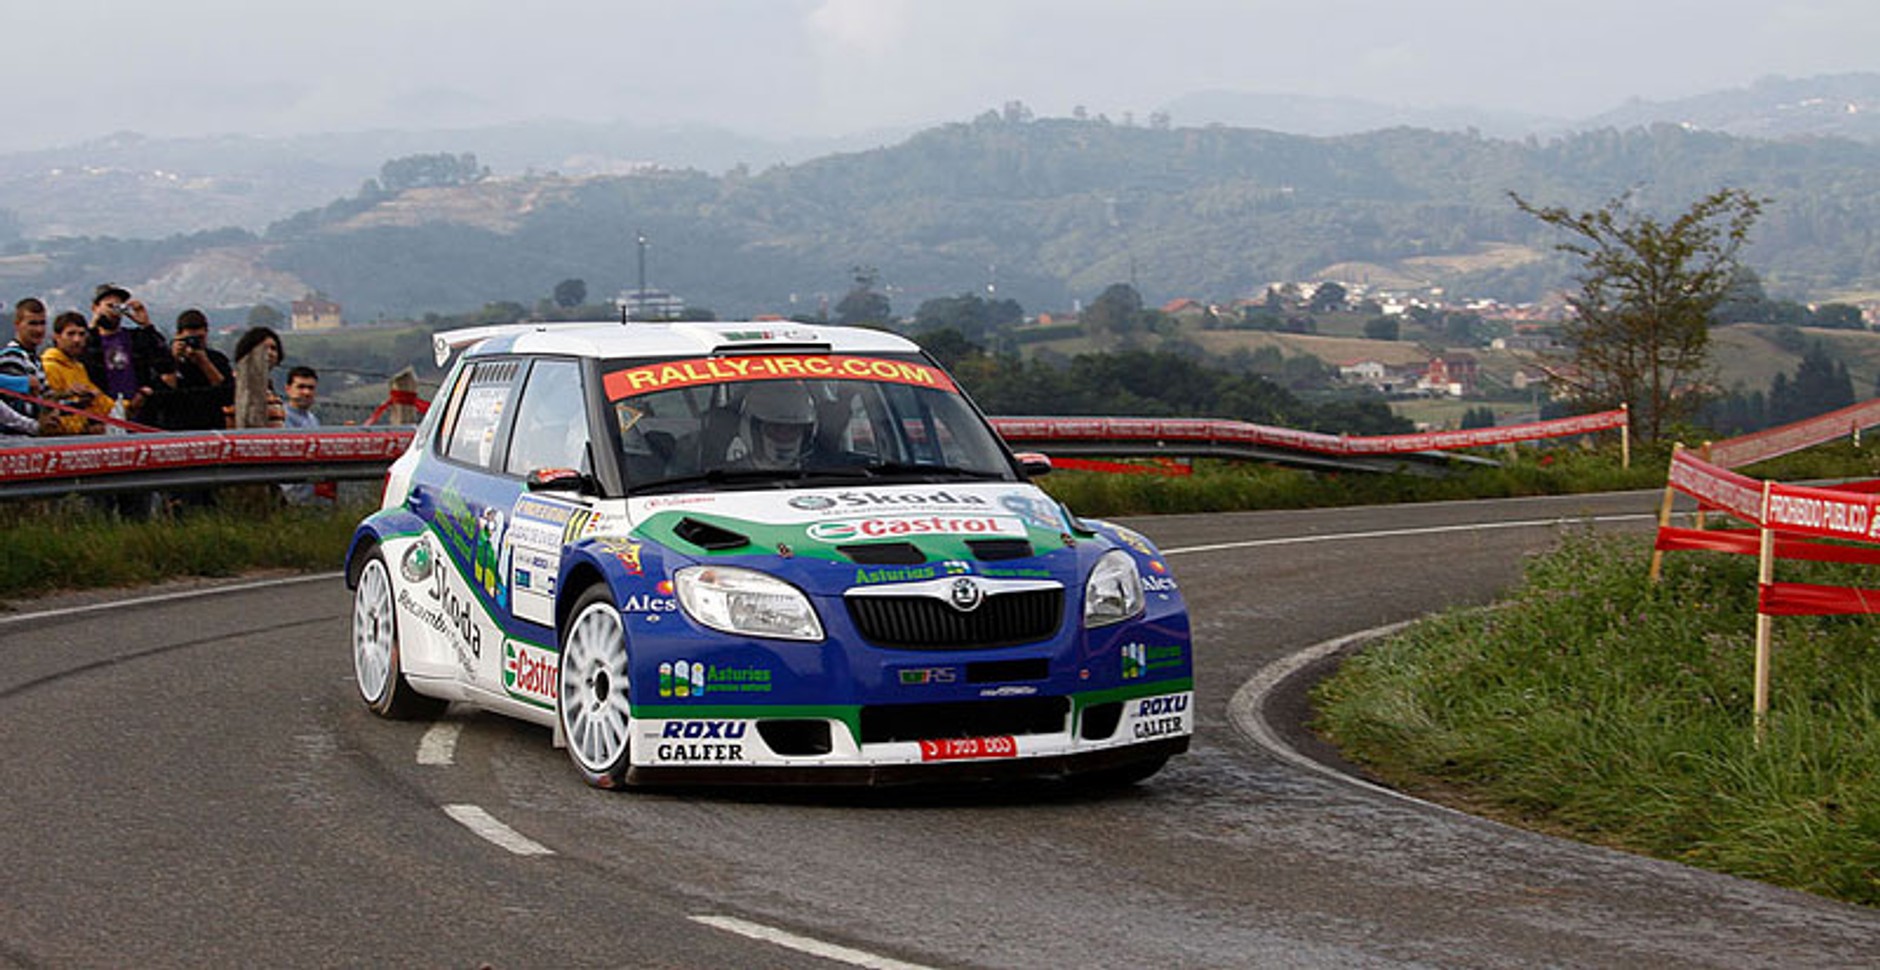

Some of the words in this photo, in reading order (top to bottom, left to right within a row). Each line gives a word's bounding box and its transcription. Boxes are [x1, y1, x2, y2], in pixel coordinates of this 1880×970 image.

[626, 356, 935, 390] RALLY-IRC.COM
[860, 517, 1006, 537] Castrol
[856, 567, 935, 584] Asturias
[625, 595, 677, 612] Ales
[515, 648, 559, 699] Castro
[707, 664, 772, 681] Asturias
[1139, 695, 1188, 718] ROXU
[662, 721, 747, 739] ROXU
[1134, 717, 1183, 739] GALFER
[658, 744, 744, 761] GALFER
